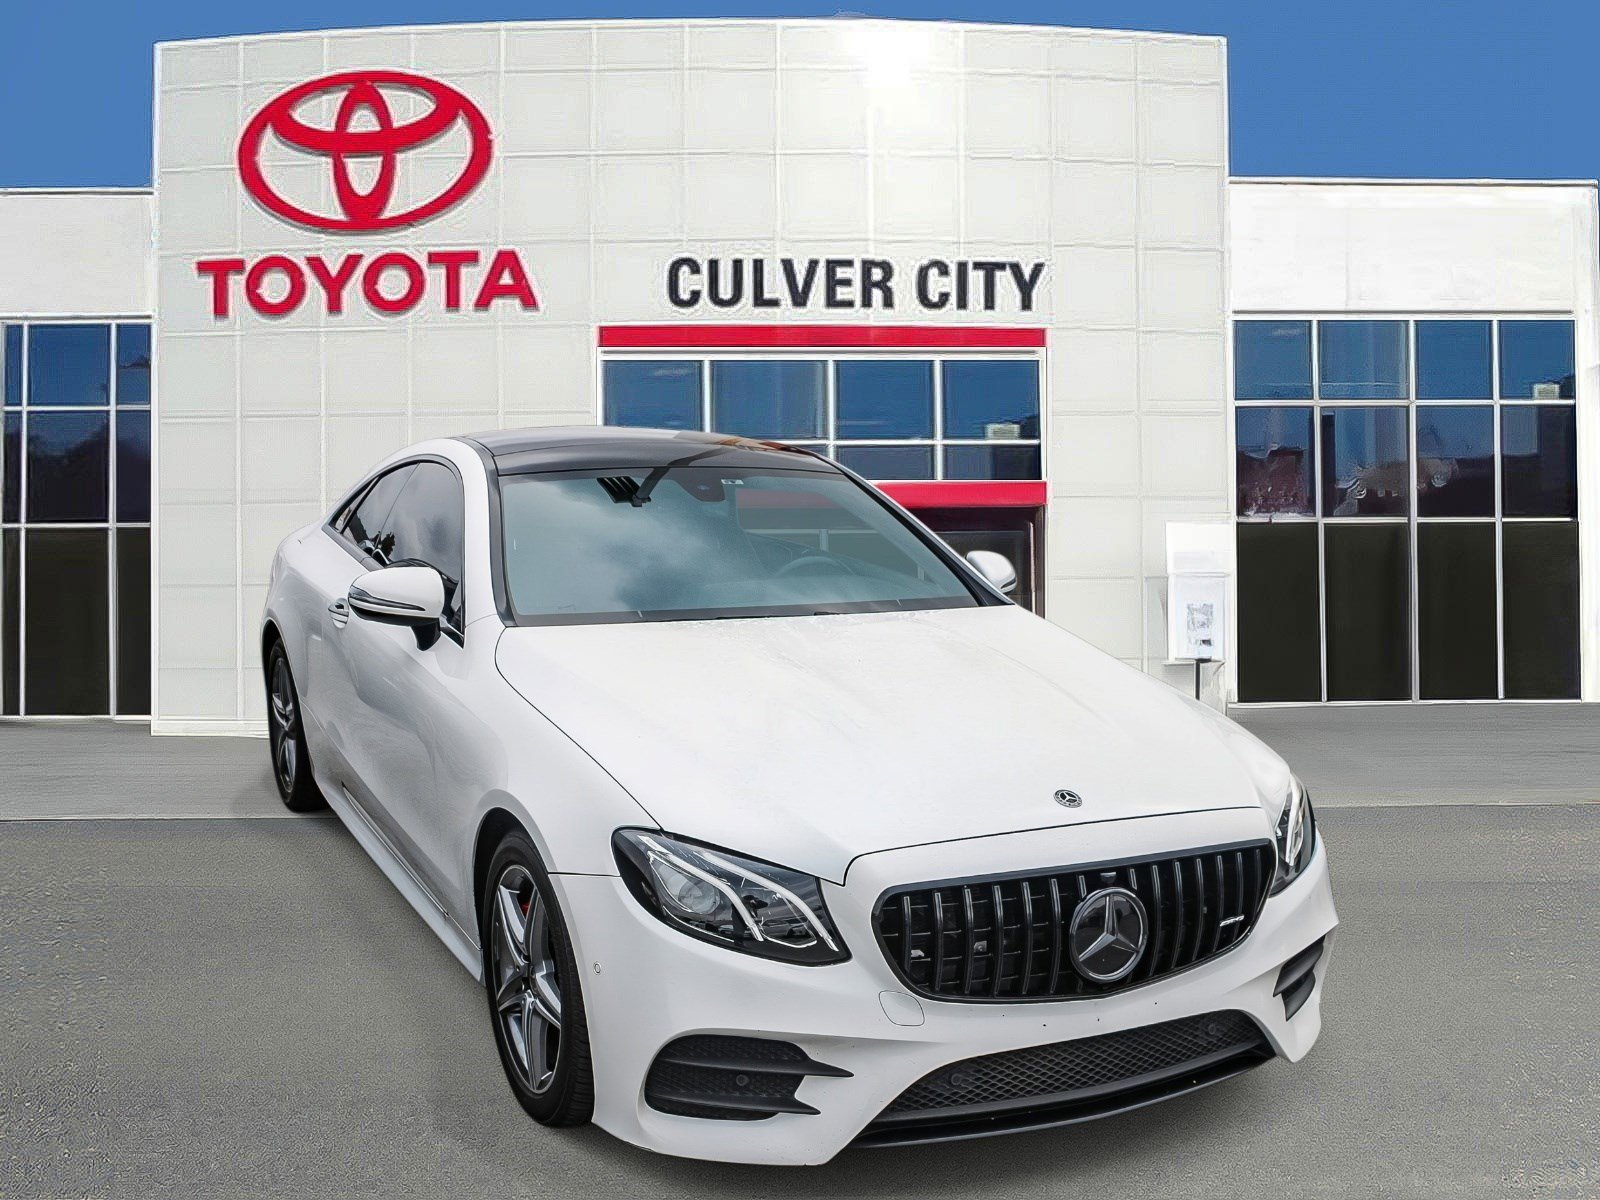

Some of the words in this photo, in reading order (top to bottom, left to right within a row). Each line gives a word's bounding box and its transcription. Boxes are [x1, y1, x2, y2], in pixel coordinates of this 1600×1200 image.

[195, 249, 540, 318] TOYOTA
[667, 257, 895, 309] CULVER
[916, 258, 1046, 311] CITY
